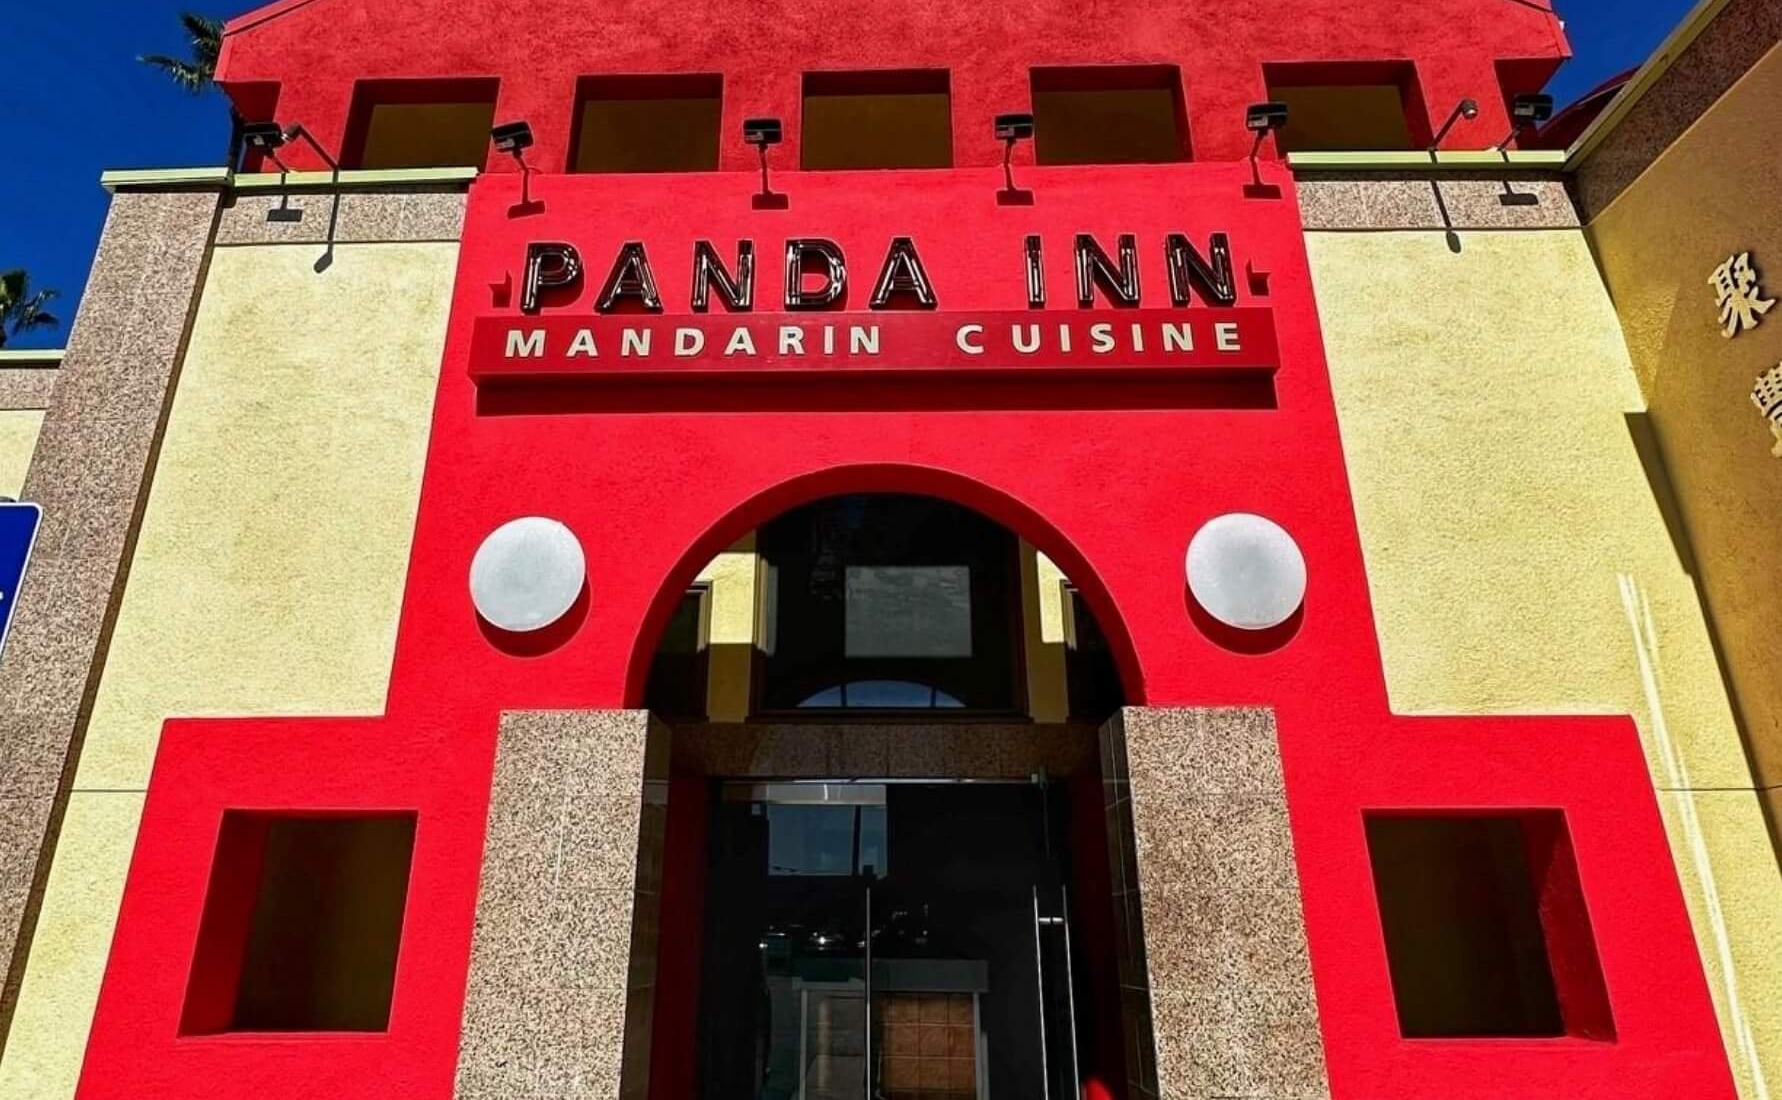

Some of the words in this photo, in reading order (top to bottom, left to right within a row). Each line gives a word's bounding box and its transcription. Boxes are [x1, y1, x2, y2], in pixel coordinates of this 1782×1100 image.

[520, 237, 939, 313] PANDA
[1024, 233, 1237, 309] INN
[504, 325, 881, 357] MANDARIN
[956, 323, 1241, 354] CUISINE
